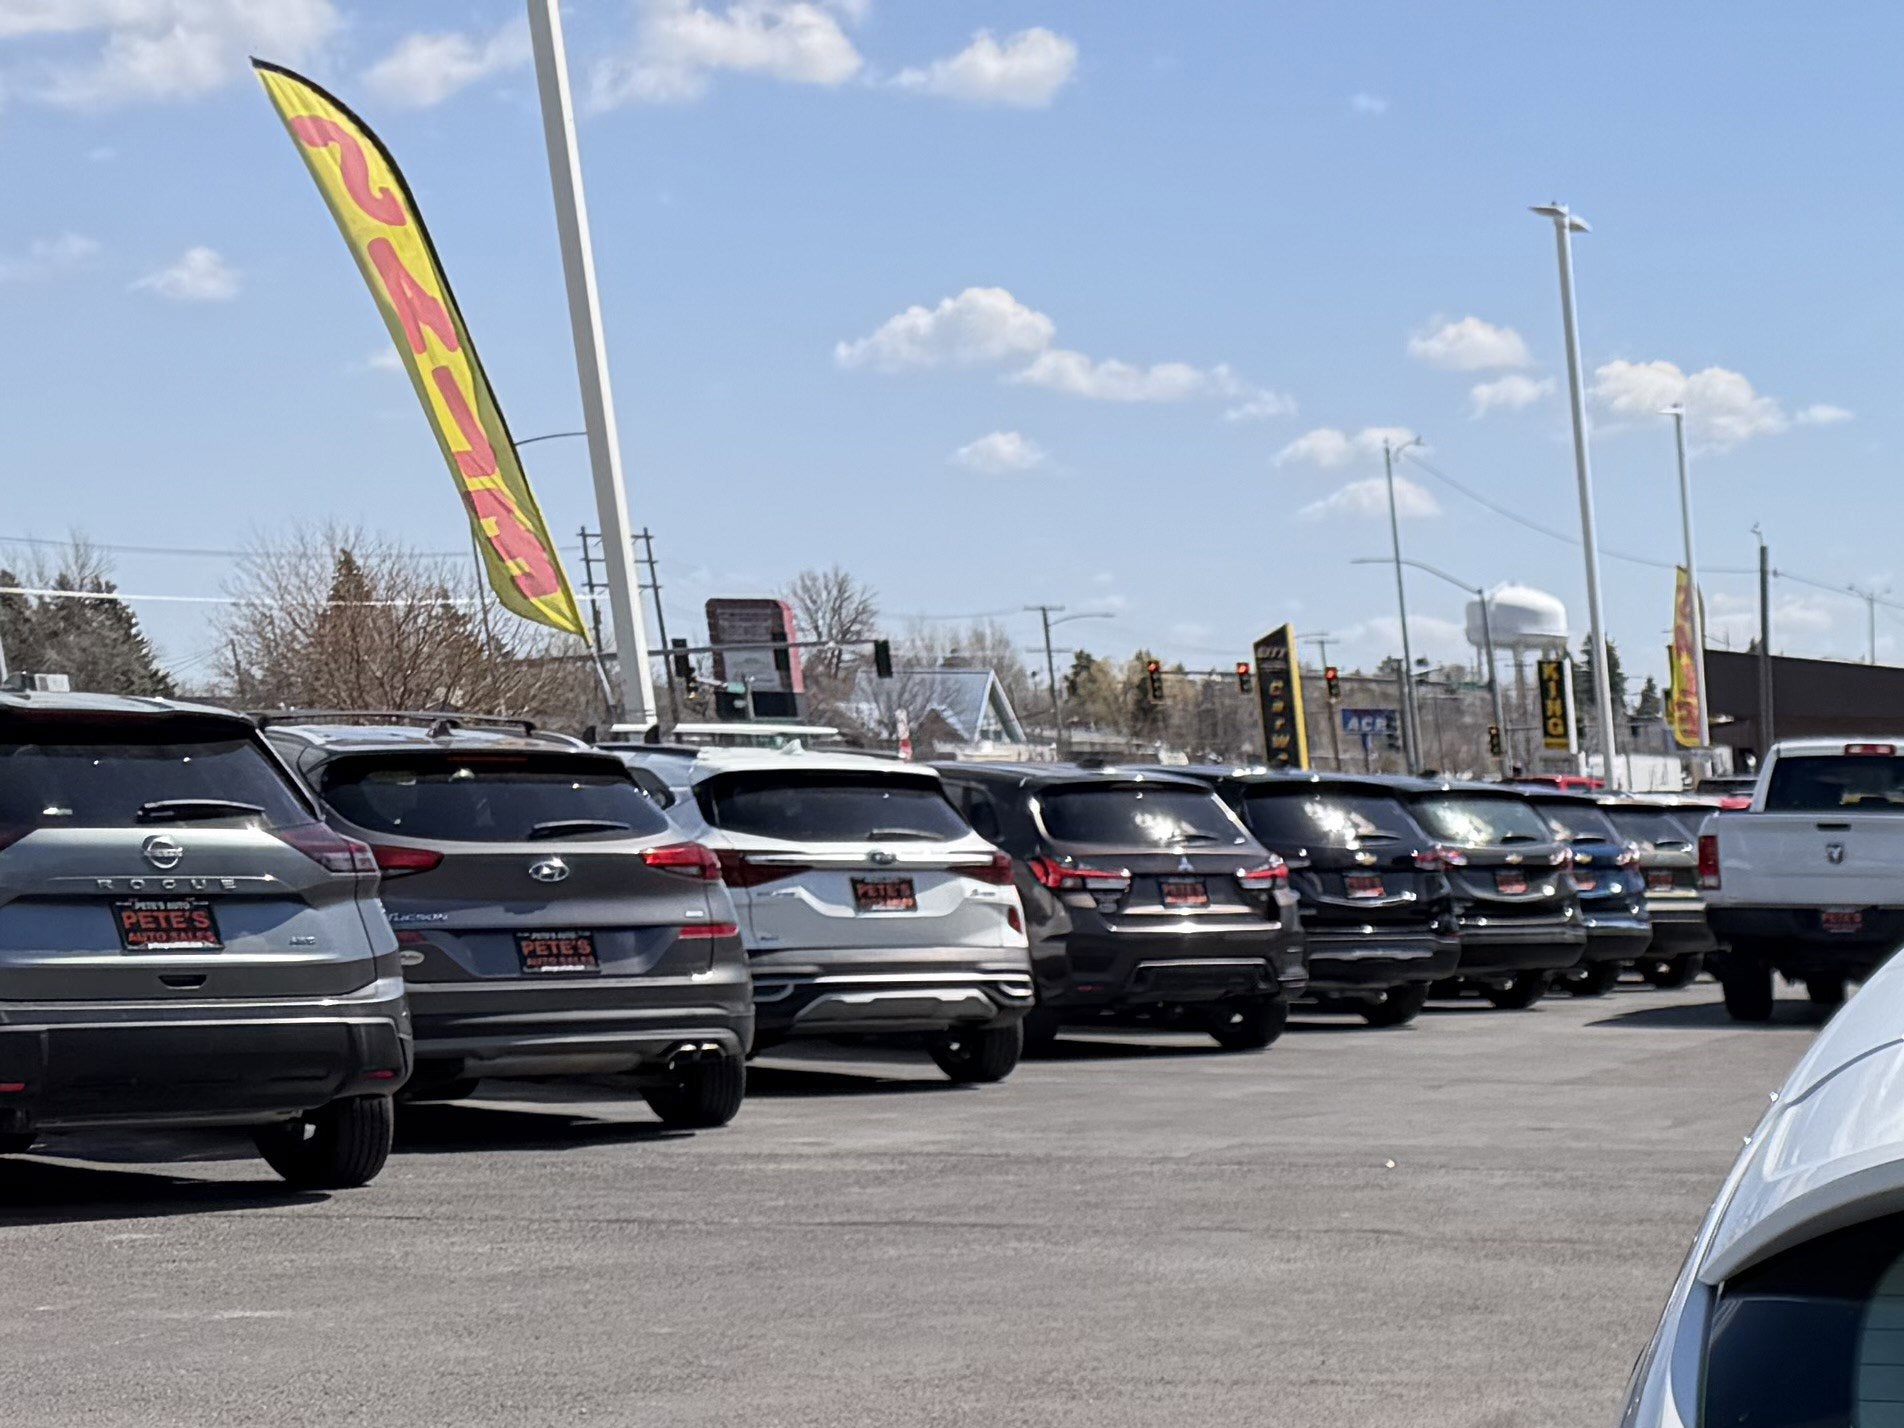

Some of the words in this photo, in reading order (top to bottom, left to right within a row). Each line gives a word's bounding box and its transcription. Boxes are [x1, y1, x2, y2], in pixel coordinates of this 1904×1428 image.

[291, 113, 561, 600] SALE
[1543, 662, 1564, 737] KING
[97, 878, 236, 890] ROGUE
[122, 911, 212, 929] PETE'S
[128, 931, 160, 943] AUTO
[521, 940, 592, 956] PETE'S
